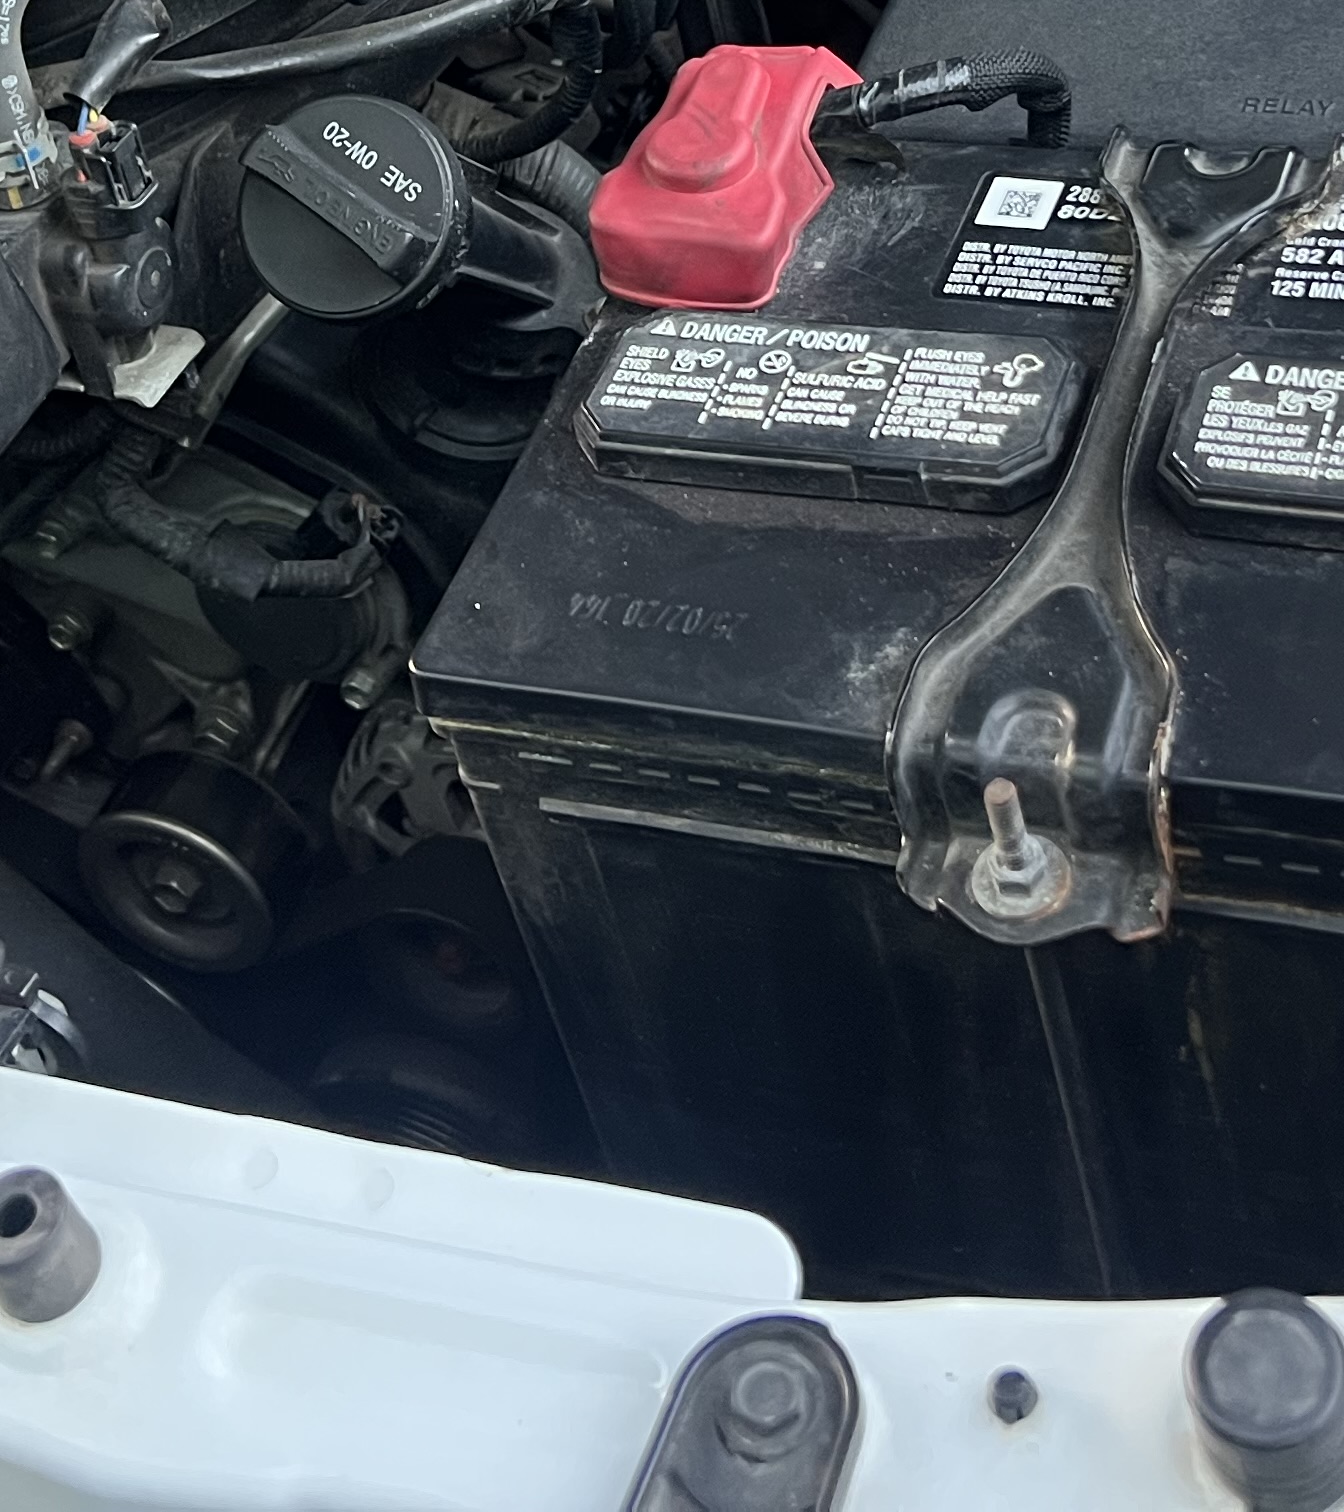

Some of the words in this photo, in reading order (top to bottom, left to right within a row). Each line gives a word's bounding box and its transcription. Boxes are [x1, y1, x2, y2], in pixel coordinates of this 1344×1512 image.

[1241, 97, 1335, 116] RELAY
[322, 121, 379, 170] 0W-20
[379, 165, 423, 202] SAE
[1280, 247, 1325, 265] 582
[1275, 268, 1329, 281] Reserve
[1270, 281, 1306, 298] 125
[626, 345, 670, 360] SHIELD
[619, 357, 653, 370] EYES
[613, 369, 676, 387] EXPLOSIVE
[735, 366, 758, 380] NO
[792, 371, 855, 388] SULFURIC
[854, 377, 887, 390] ACID
[1211, 385, 1233, 399] SE
[1202, 413, 1231, 427] LES
